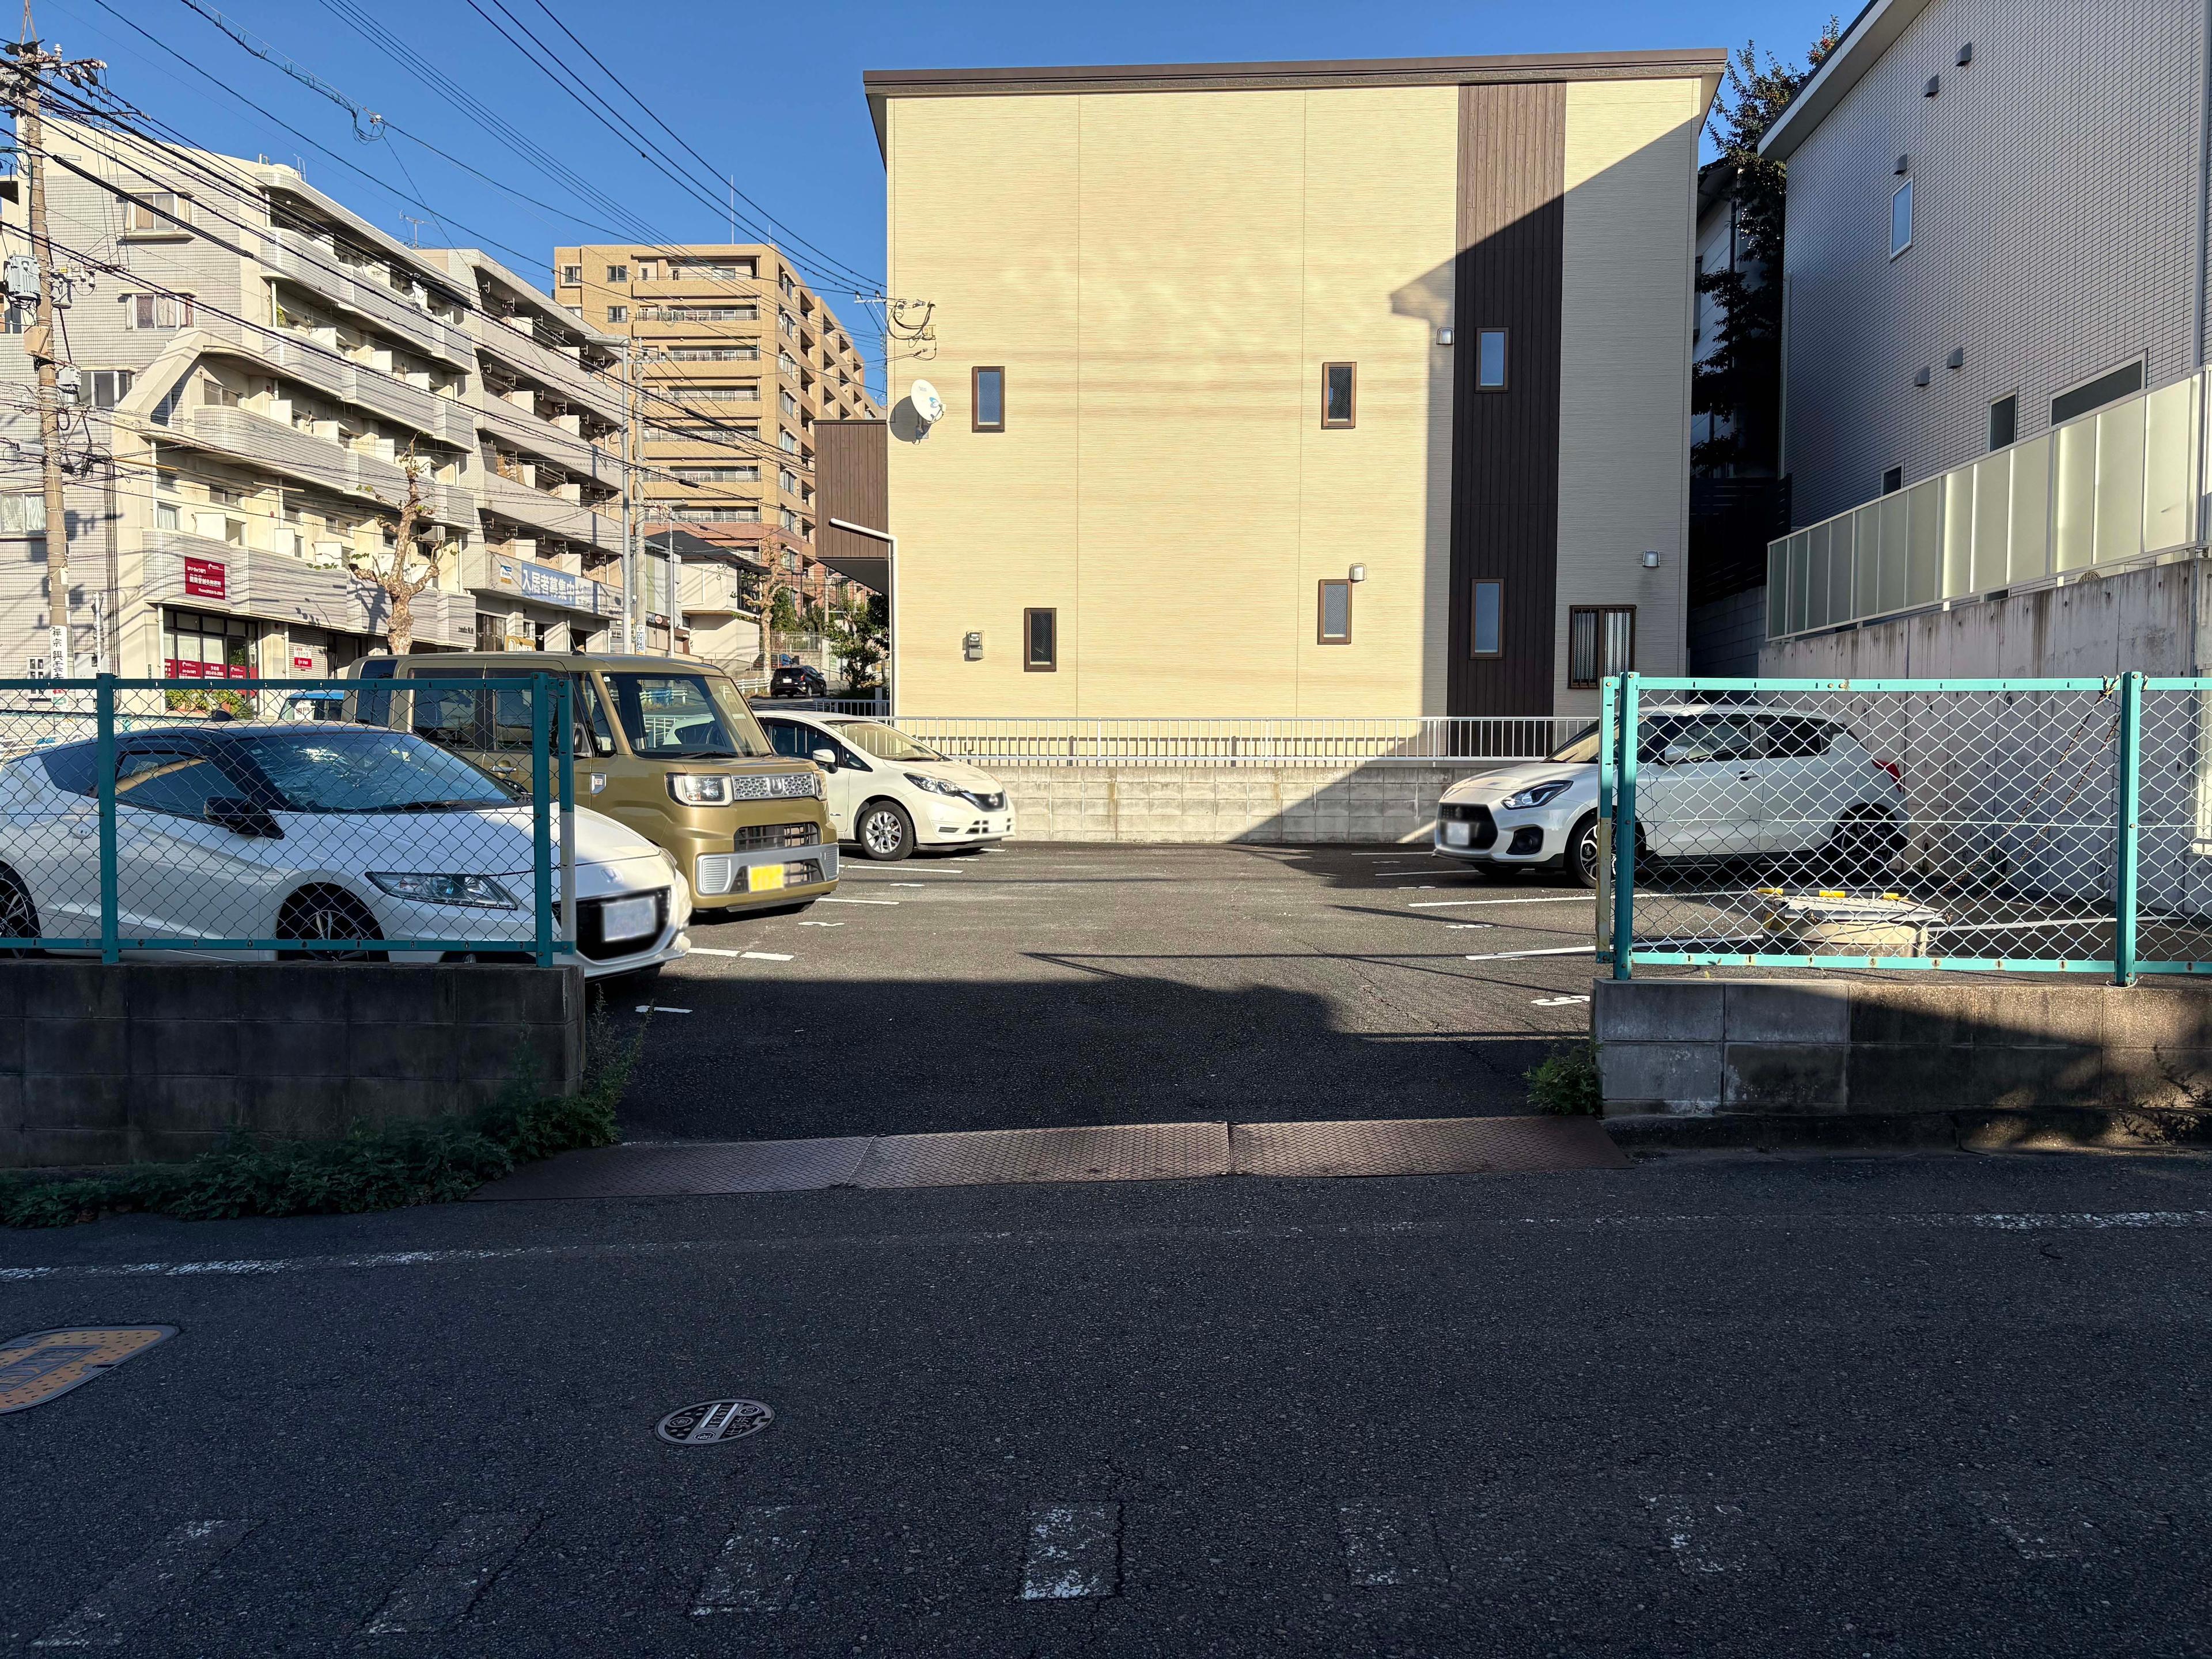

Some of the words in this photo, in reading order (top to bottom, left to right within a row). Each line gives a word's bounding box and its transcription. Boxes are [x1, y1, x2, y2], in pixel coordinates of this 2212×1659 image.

[522, 569, 575, 601] 入居者募集中
